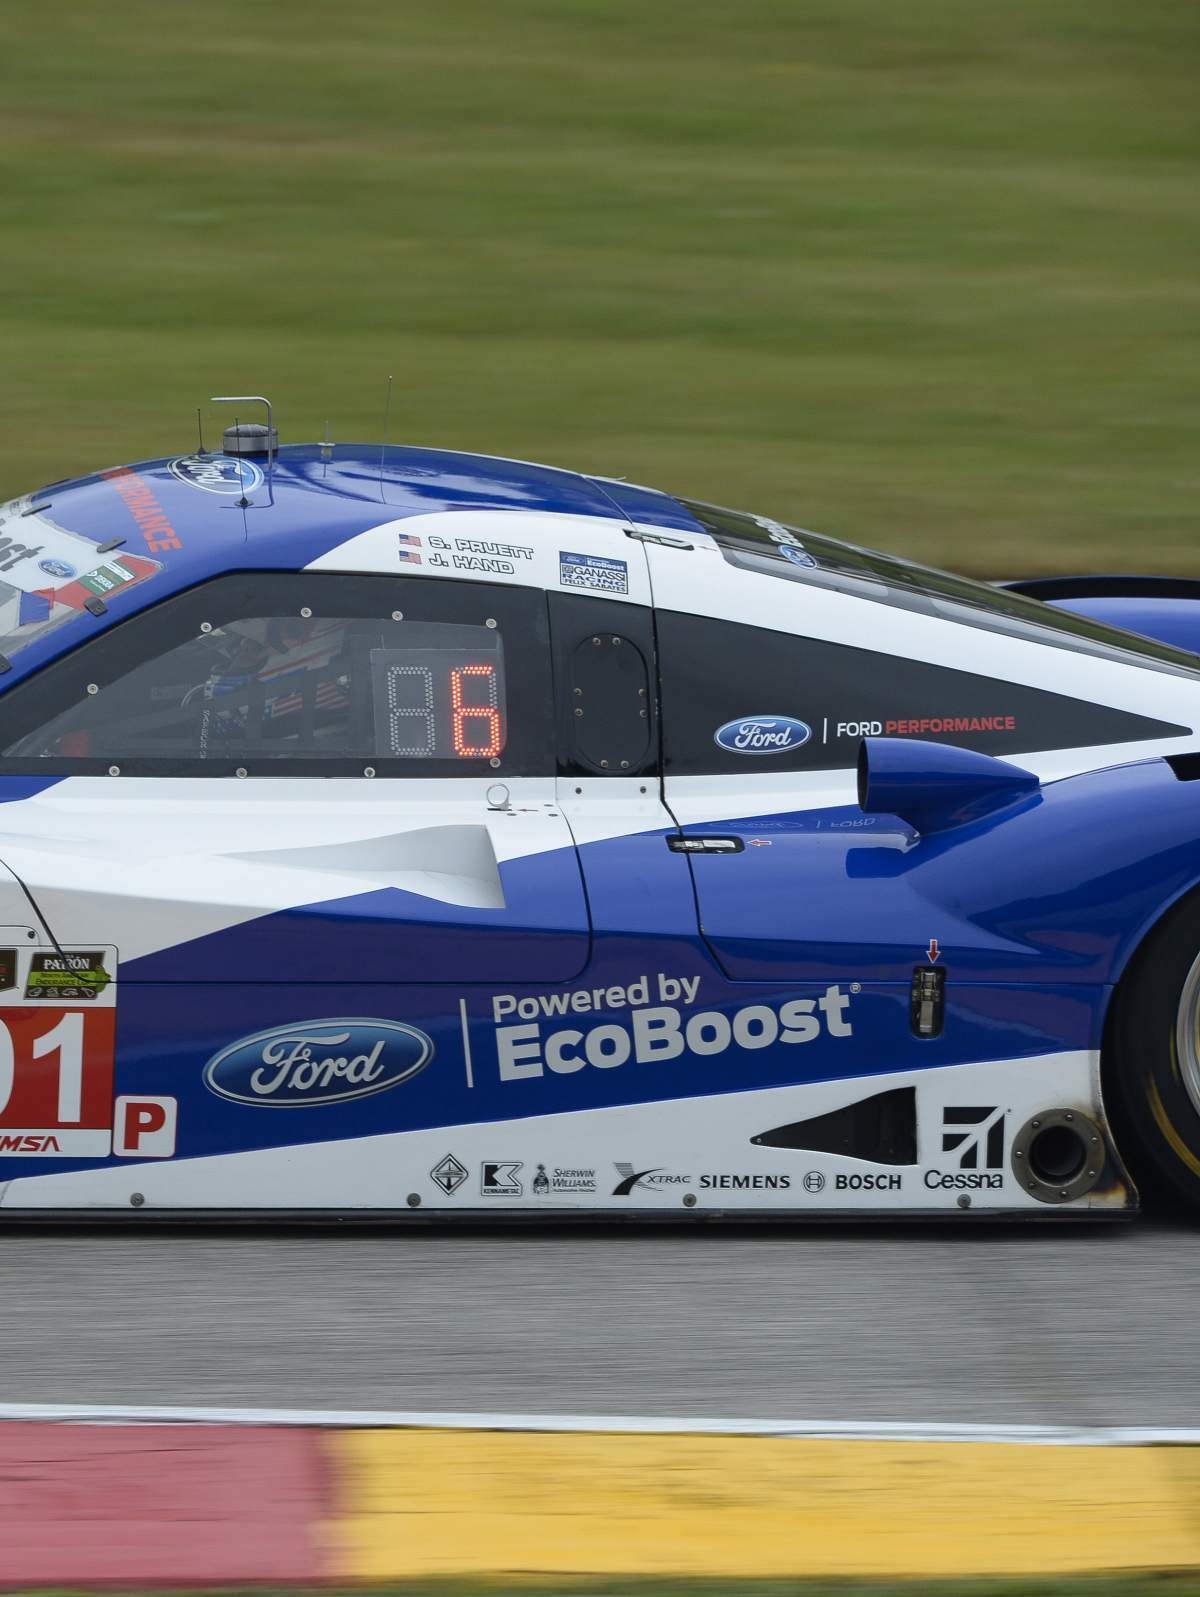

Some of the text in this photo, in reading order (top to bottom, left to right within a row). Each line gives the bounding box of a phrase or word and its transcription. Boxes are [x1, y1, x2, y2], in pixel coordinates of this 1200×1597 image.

[428, 536, 534, 560] S. PRUETT
[429, 554, 515, 575] J. HAND
[573, 566, 626, 581] GANASSI
[562, 574, 626, 587] RACING
[734, 720, 792, 750] Ford
[836, 716, 1016, 738] FORD PERFORMANCE
[492, 972, 701, 1023] Powered by
[249, 1032, 387, 1095] Ford
[123, 1102, 167, 1151] P
[553, 1168, 595, 1178] SHERWIN
[646, 1175, 692, 1184] XTRAC
[699, 1174, 791, 1189] SIEMENS
[835, 1173, 902, 1190] BOSCH
[924, 1169, 1004, 1190] Cessna
